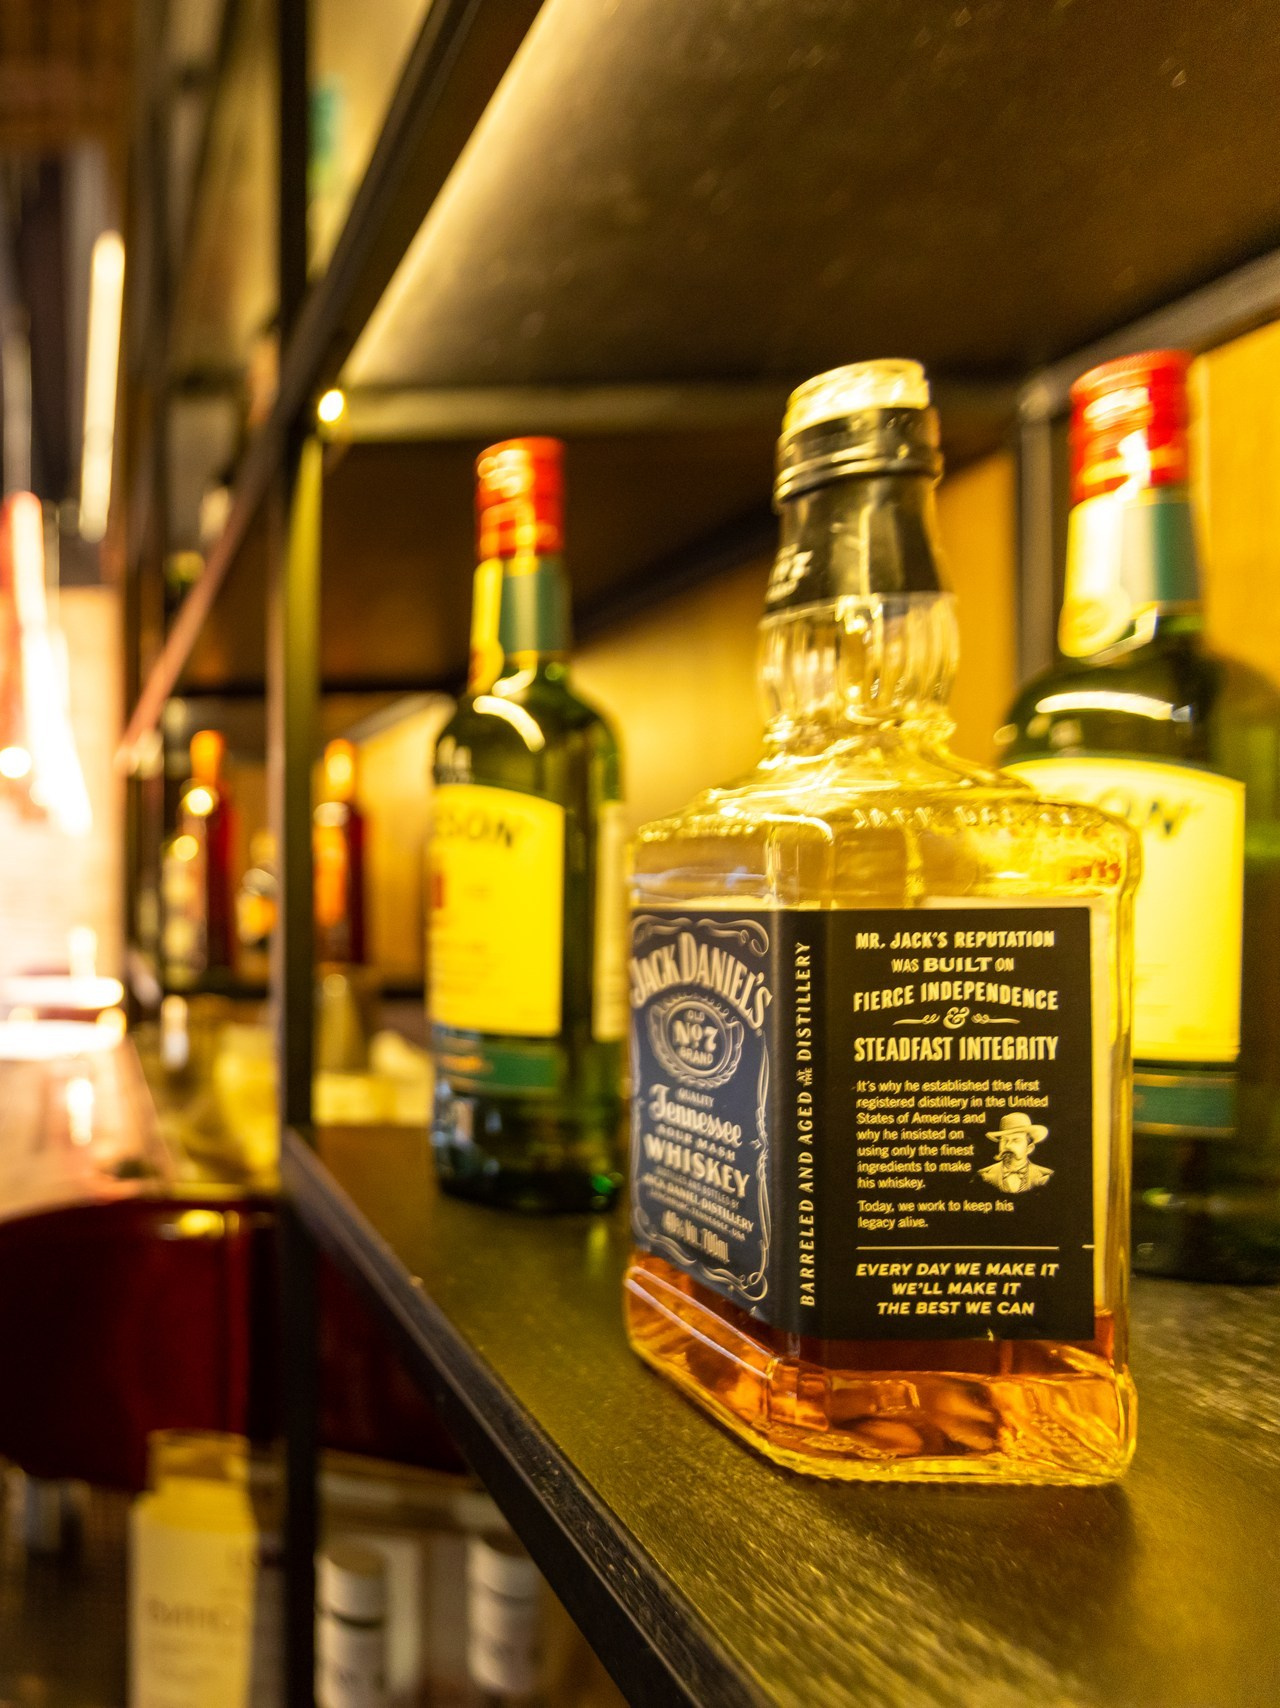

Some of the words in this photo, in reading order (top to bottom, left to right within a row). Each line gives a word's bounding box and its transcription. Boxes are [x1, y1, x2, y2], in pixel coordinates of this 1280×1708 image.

[856, 932, 885, 950] MR.
[890, 931, 948, 949] JACK'S
[954, 930, 1055, 948] REPUTATION
[891, 958, 919, 973] WAS
[923, 957, 993, 973] BUILT
[994, 958, 1015, 972] ON
[630, 943, 681, 1010] JACK
[678, 931, 773, 1030] DANIEL'S
[795, 942, 812, 1062] DISTILLERY
[853, 985, 915, 1012] FIERCE
[920, 981, 1059, 1010] INDEPENDENCE
[942, 1007, 970, 1029] &
[853, 1037, 954, 1062] STEADFAST
[959, 1036, 1059, 1061] INTEGRITY
[856, 1079, 876, 1092] It's
[878, 1081, 902, 1094] why
[904, 1079, 920, 1092] he
[921, 1079, 990, 1092] established
[991, 1079, 1013, 1092] the
[1014, 1079, 1039, 1091] first
[856, 1096, 915, 1110] registered
[919, 1096, 969, 1110] distillery
[970, 1096, 982, 1108] in
[985, 1096, 1006, 1108] the
[1008, 1095, 1049, 1108] United
[648, 1083, 743, 1149] Tennessee
[797, 1092, 814, 1145] AGED
[856, 1112, 894, 1124] States
[896, 1112, 910, 1124] of
[911, 1112, 961, 1124] America
[962, 1112, 986, 1124] and
[856, 1129, 880, 1142] why
[882, 1128, 898, 1140] he
[900, 1128, 947, 1140] insisted
[949, 1130, 964, 1140] on
[857, 1144, 889, 1159] using
[891, 1144, 917, 1158] only
[918, 1144, 939, 1156] the
[940, 1144, 975, 1156] finest
[643, 1133, 751, 1199] WHISKEY
[797, 1151, 814, 1193] AND
[857, 1160, 922, 1175] ingredients
[924, 1161, 937, 1173] to
[939, 1160, 972, 1173] make
[857, 1177, 876, 1189] his
[877, 1177, 926, 1191] whiskey.
[858, 1200, 895, 1214] Today,
[897, 1202, 915, 1212] we
[917, 1200, 946, 1212] work
[948, 1201, 961, 1212] to
[963, 1200, 992, 1214] keep
[994, 1200, 1014, 1212] his
[700, 1198, 754, 1233] DISTILLERY
[858, 1217, 895, 1230] legacy
[897, 1217, 928, 1228] alive.
[799, 1199, 816, 1307] BARRELED
[856, 1263, 913, 1276] EVERY
[916, 1263, 951, 1276] DAY
[954, 1263, 981, 1275] WE
[985, 1263, 1035, 1275] MAKE
[1040, 1263, 1059, 1276] IT
[892, 1282, 942, 1295] WE'LL
[947, 1282, 997, 1295] MAKE
[1002, 1282, 1021, 1295] IT
[877, 1301, 911, 1315] THE
[915, 1301, 960, 1315] BEST
[965, 1301, 991, 1315] WE
[996, 1301, 1035, 1315] CAN
